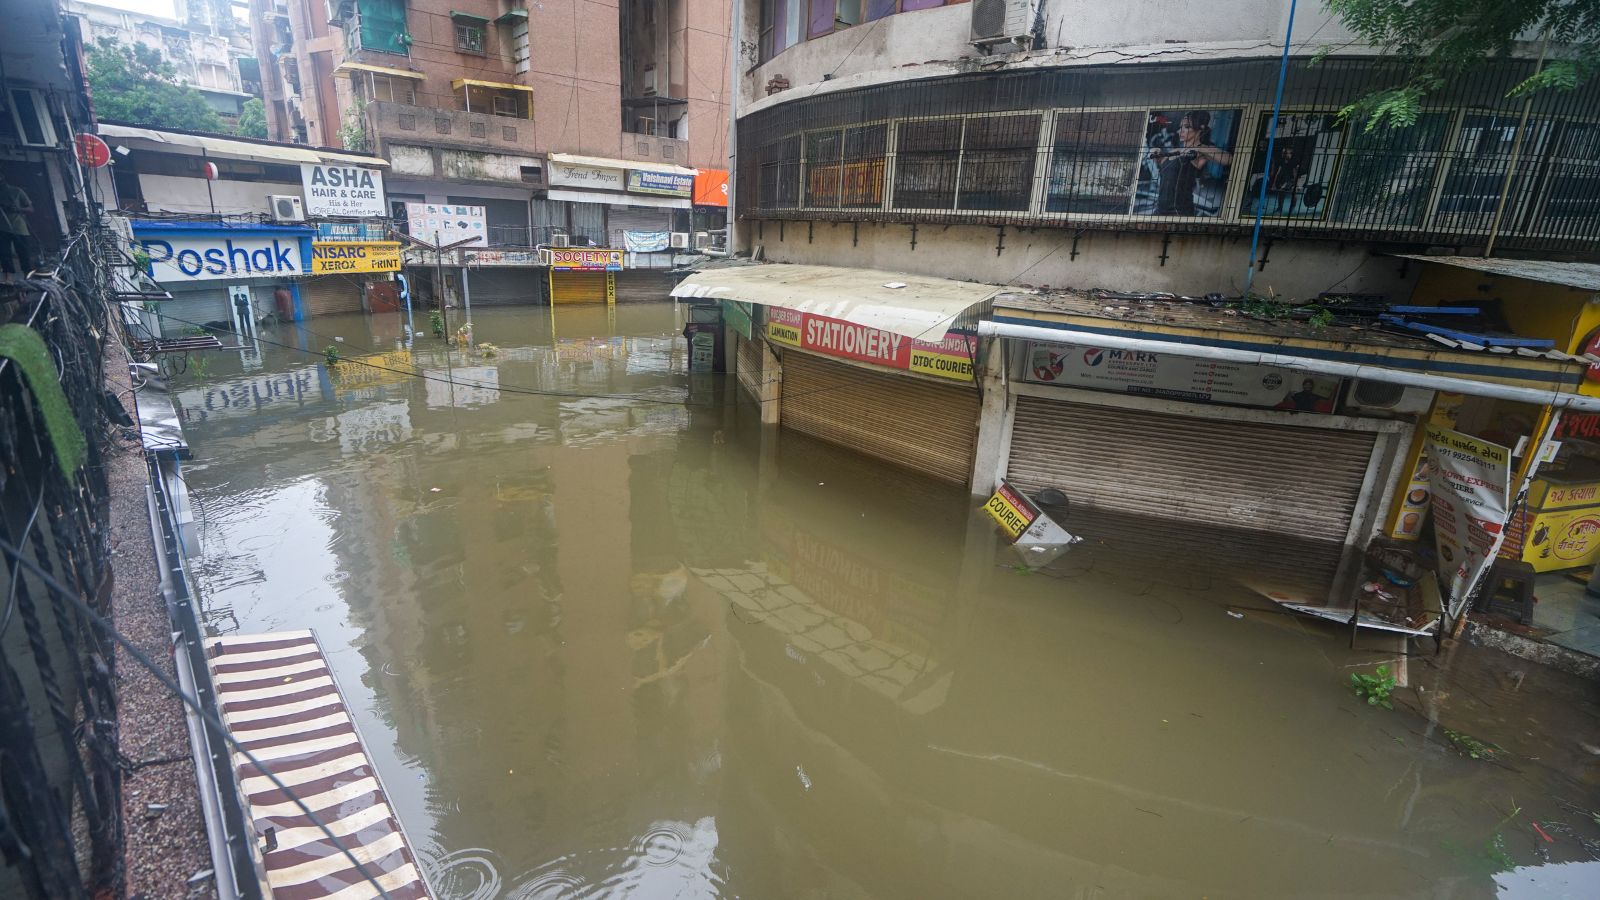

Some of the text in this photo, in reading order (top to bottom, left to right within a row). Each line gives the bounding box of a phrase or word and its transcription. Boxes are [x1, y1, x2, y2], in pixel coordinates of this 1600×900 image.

[311, 166, 375, 189] ASHA
[563, 167, 618, 182] Trend Impex
[312, 188, 377, 200] HAIR & CARE
[141, 238, 296, 278] Poshak
[312, 247, 367, 259] NISARG
[554, 251, 609, 262] SOCIETY
[321, 260, 356, 271] XEROX
[371, 259, 398, 269] PRINT
[771, 325, 798, 342] LAMINATION
[807, 319, 903, 361] STATIONERY
[1109, 350, 1158, 363] MARK
[912, 355, 973, 375] DTDC COURIER
[1482, 446, 1502, 462] સેવા
[1466, 476, 1504, 494] EXPRESS
